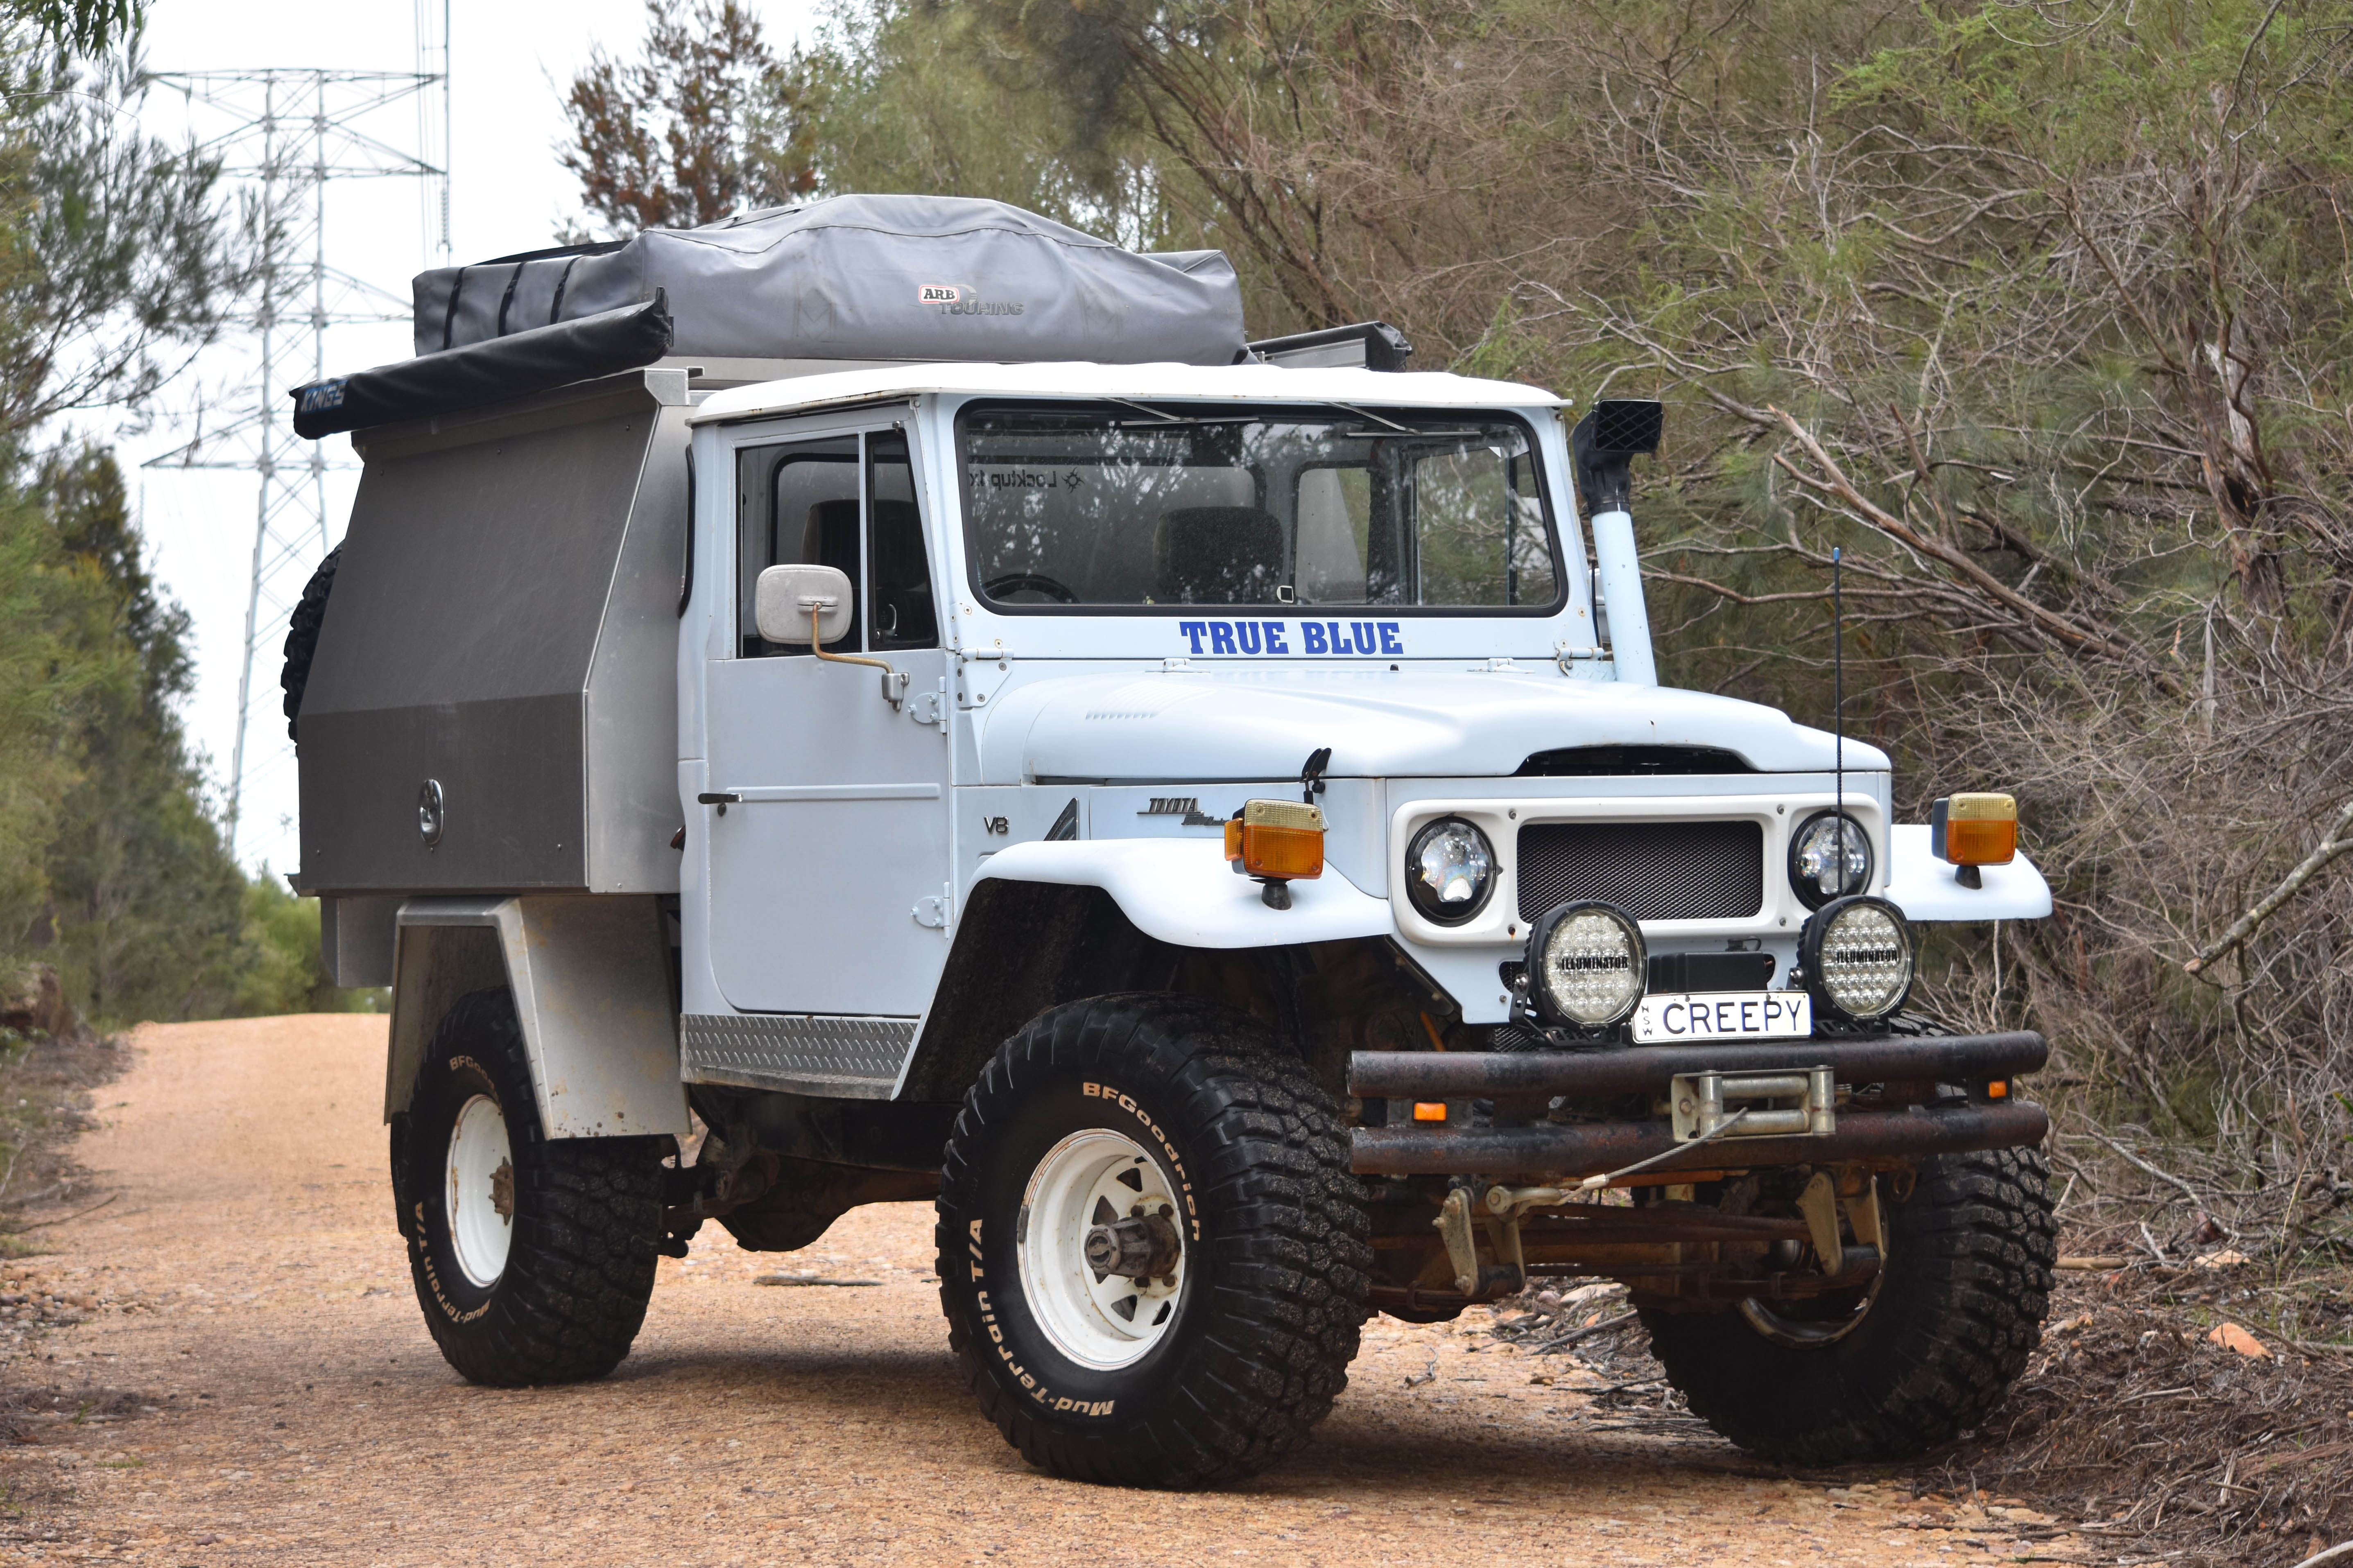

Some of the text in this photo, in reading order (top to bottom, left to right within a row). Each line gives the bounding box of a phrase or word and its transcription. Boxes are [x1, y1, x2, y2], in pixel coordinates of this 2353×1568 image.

[923, 288, 956, 300] ARB
[941, 302, 1023, 315] TOURING
[300, 382, 347, 412] KINGS
[1179, 621, 1404, 655] TRUE BLUE
[1149, 798, 1198, 813] TOYOTA
[984, 816, 1009, 834] V8
[1561, 956, 1628, 970] ILLUMINATOR
[1837, 951, 1898, 963] ILLUMINATOR
[1663, 1000, 1801, 1035] CREEPY
[1083, 1082, 1200, 1241] BFGoodrich
[415, 1202, 428, 1252] T/A
[969, 1218, 1115, 1416] Mud-Terrain T/A
